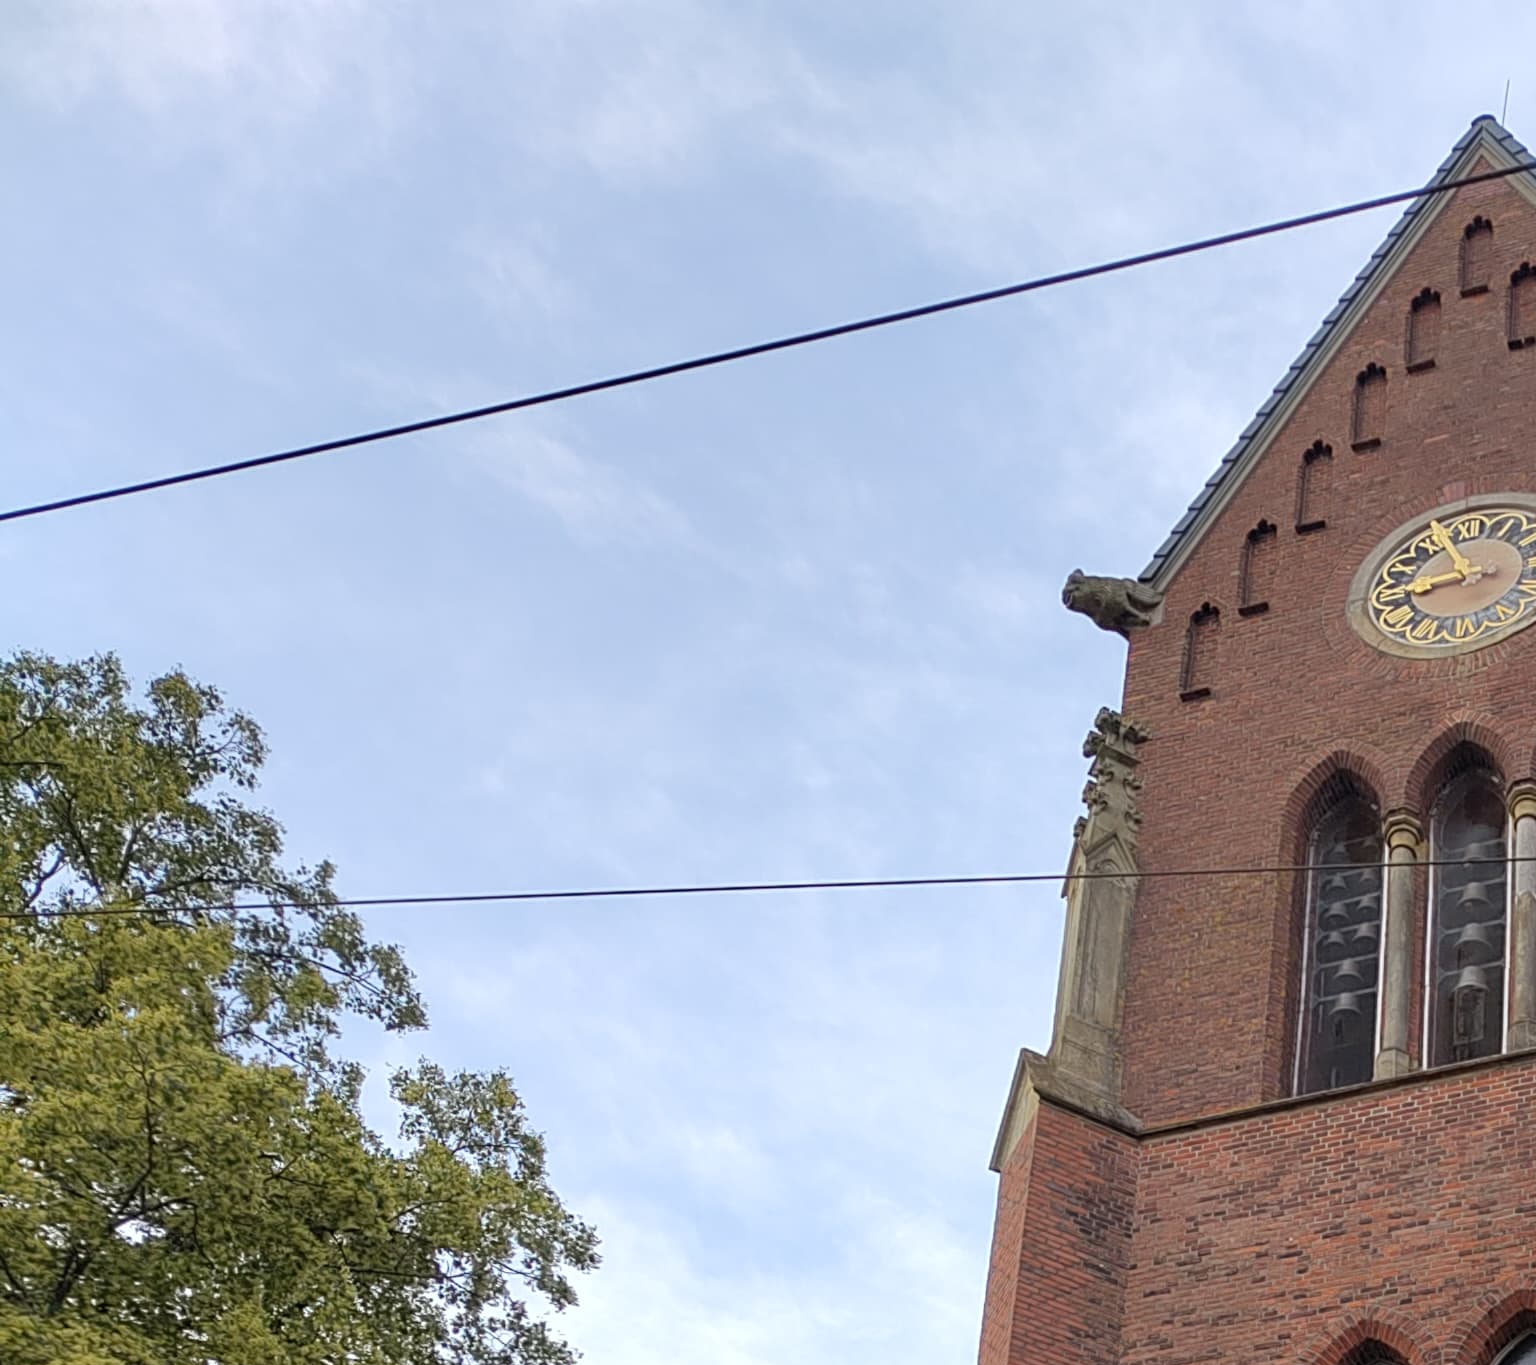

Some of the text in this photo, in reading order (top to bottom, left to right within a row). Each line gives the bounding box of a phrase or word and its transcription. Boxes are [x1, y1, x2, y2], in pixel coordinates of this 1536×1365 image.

[1458, 519, 1480, 541] XII
[1497, 519, 1515, 537] I
[1389, 562, 1417, 575] X
[1379, 584, 1406, 602] IX
[1384, 604, 1415, 629] VIII
[1495, 604, 1516, 620] V
[1411, 617, 1439, 639] VII
[1456, 617, 1475, 637] VI
